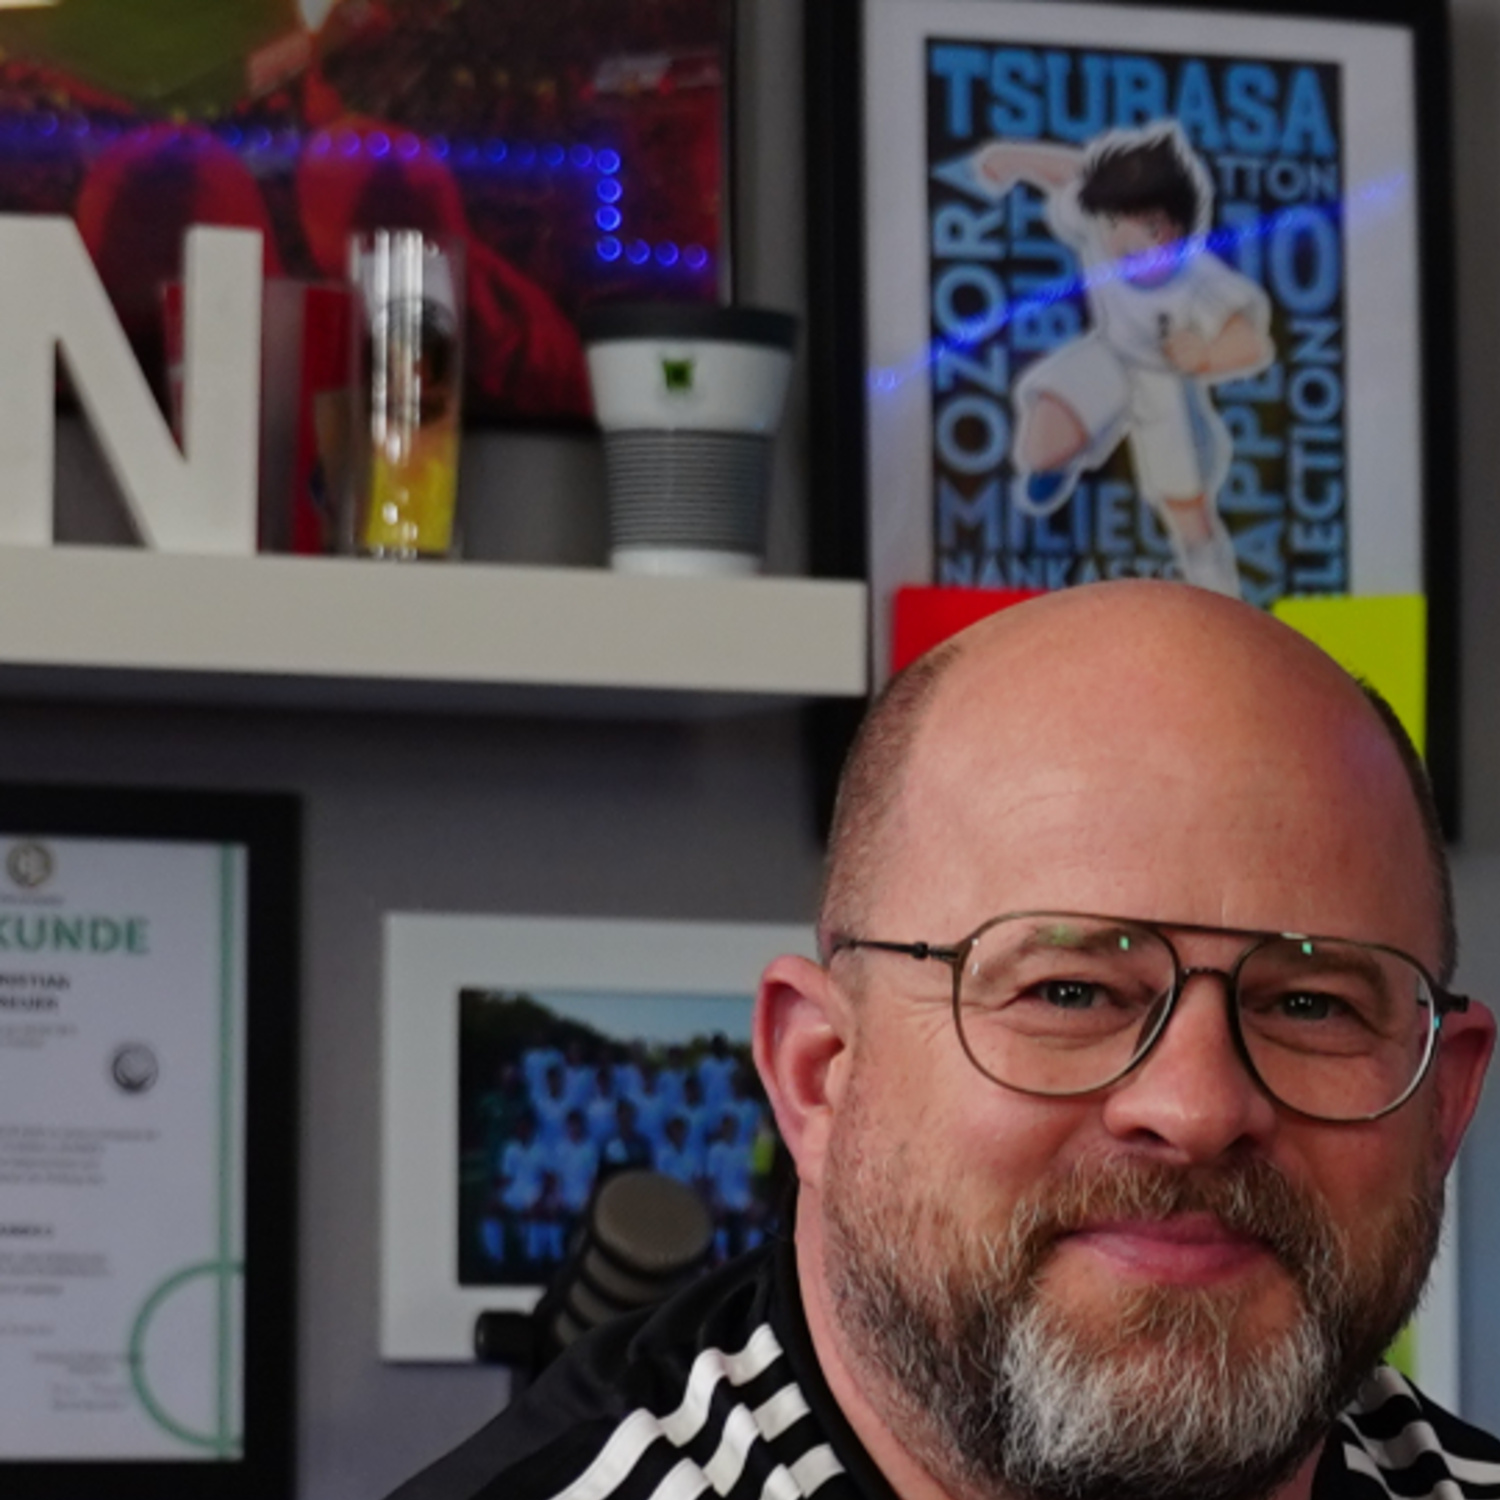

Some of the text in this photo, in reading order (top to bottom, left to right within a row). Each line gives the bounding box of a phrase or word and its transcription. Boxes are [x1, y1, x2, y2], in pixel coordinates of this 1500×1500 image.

[931, 46, 1337, 156] TSUBASA
[0, 216, 264, 556] N
[1289, 316, 1342, 597] LECTION
